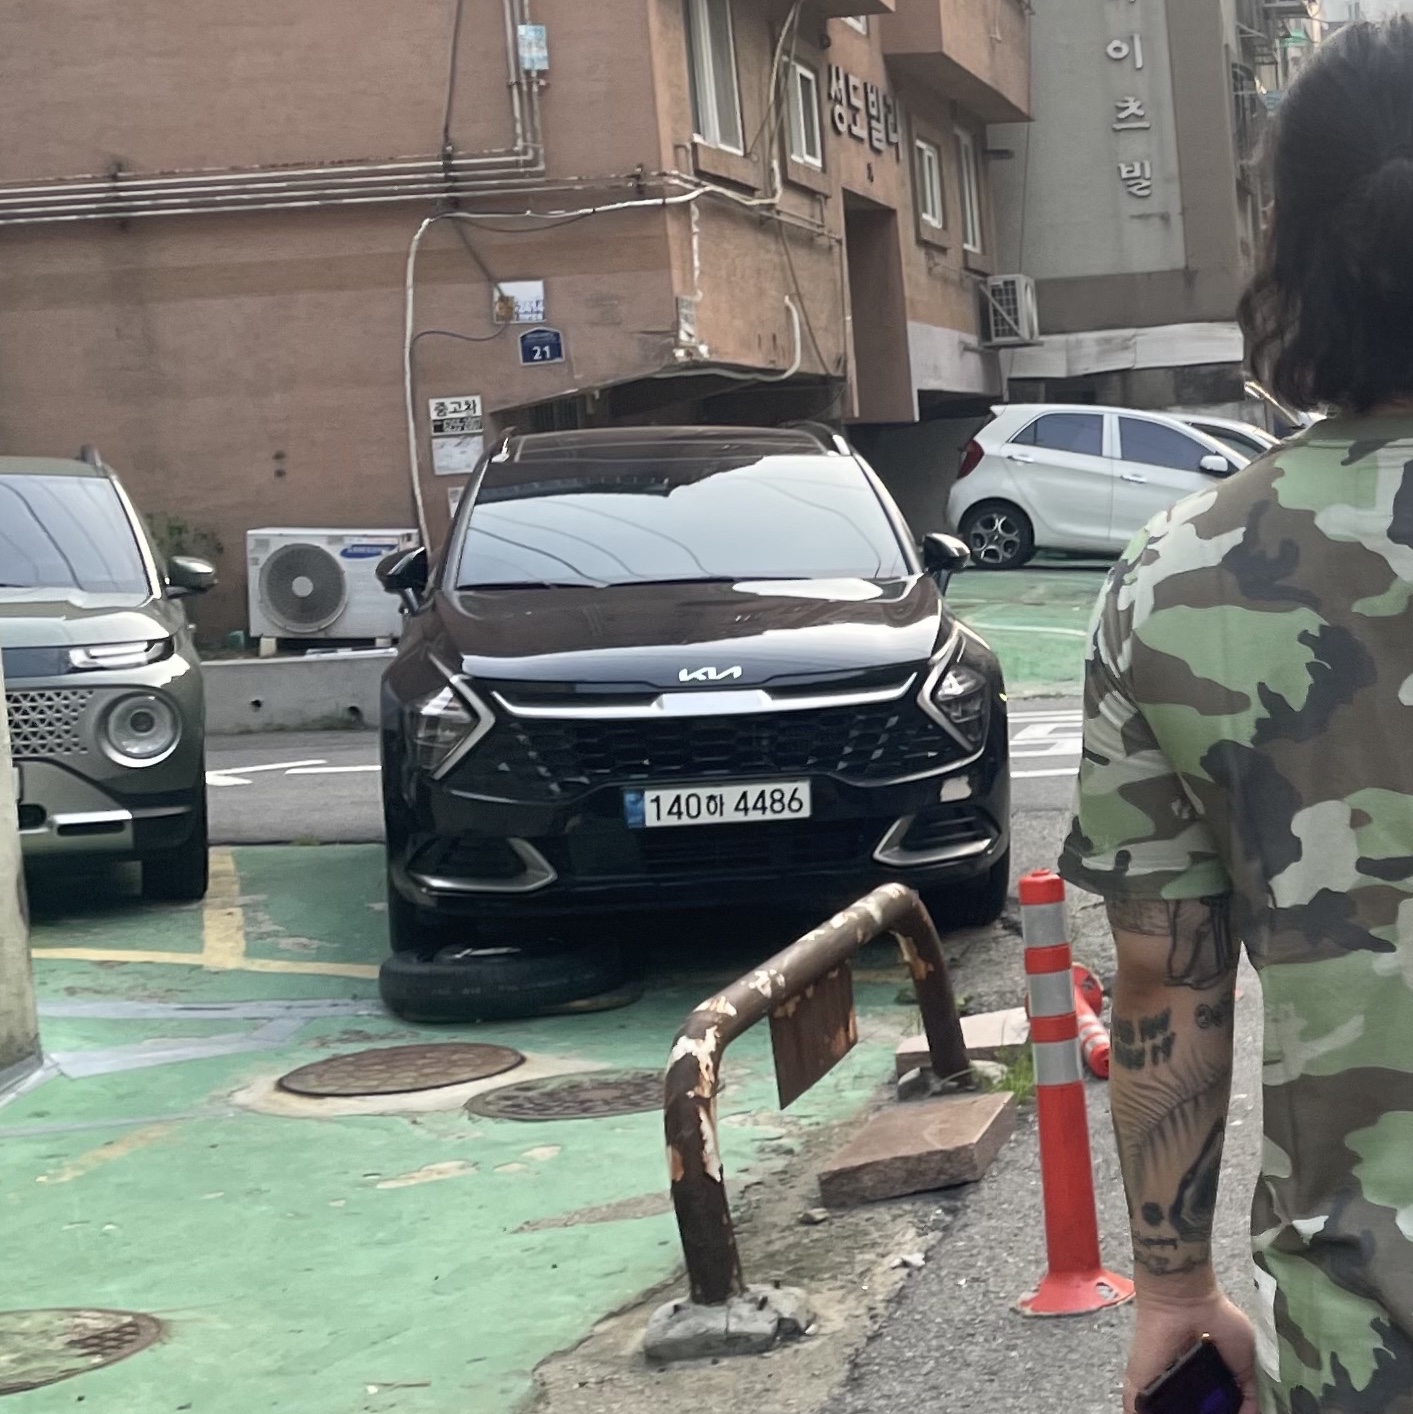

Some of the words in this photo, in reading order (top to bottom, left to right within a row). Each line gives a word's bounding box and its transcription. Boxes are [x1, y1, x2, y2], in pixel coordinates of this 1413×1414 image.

[1106, 0, 1151, 197] 이츠빌
[533, 345, 551, 360] 21
[734, 787, 804, 817] 4486
